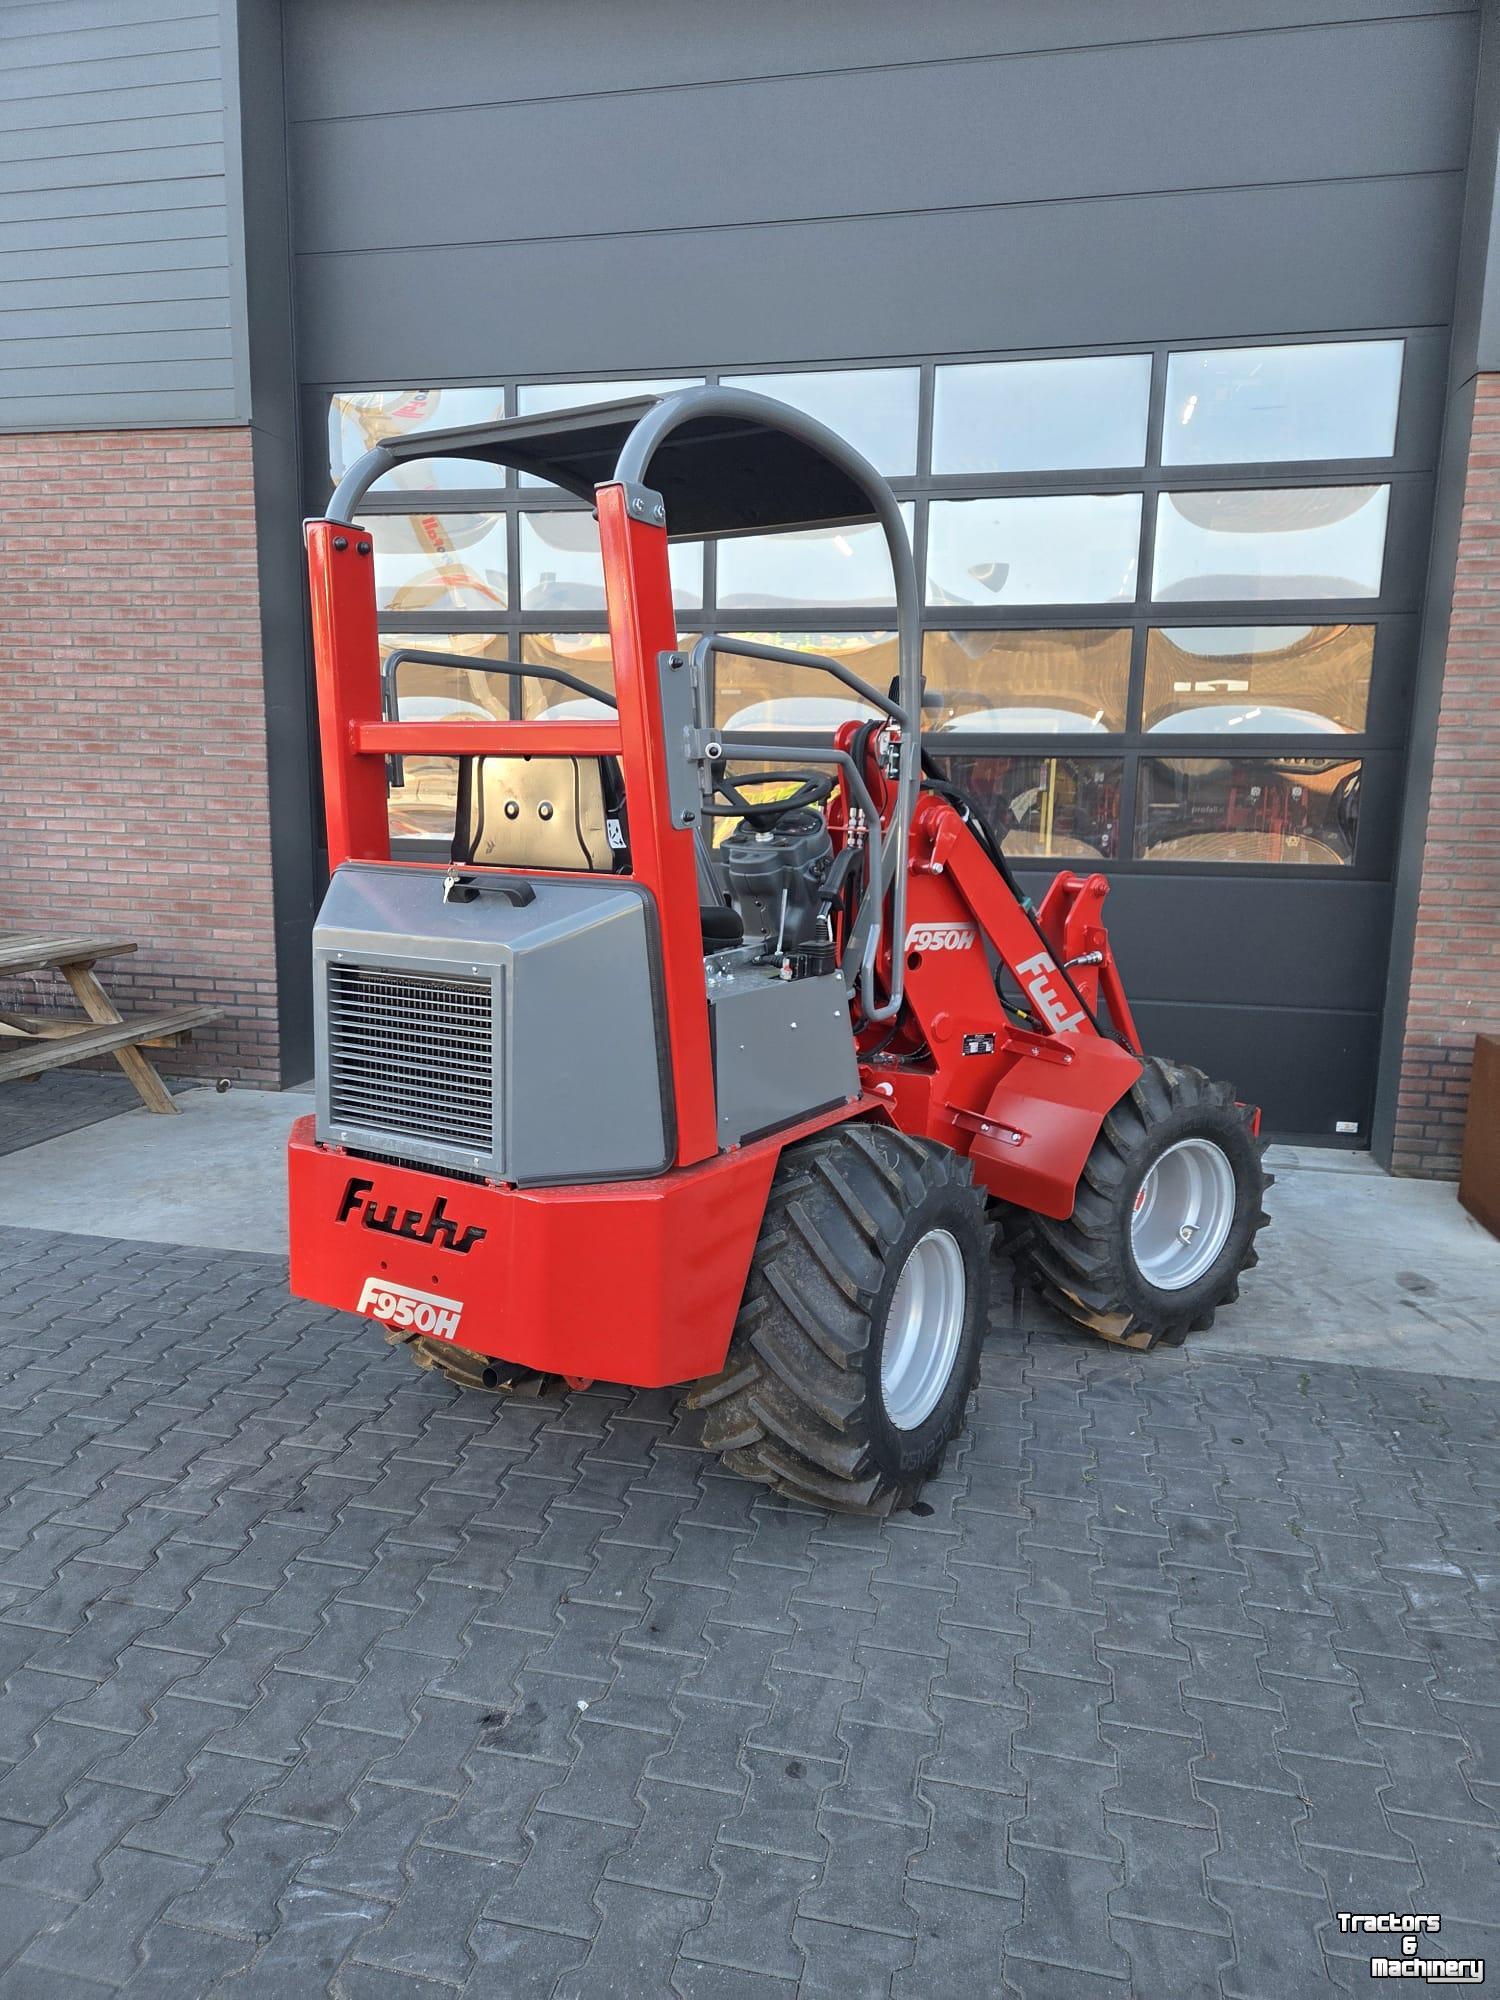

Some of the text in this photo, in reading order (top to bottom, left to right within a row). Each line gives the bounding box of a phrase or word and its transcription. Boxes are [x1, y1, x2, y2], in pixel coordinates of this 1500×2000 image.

[904, 922, 977, 951] F950H
[1015, 951, 1086, 1033] Fuch
[356, 1277, 464, 1340] F950H
